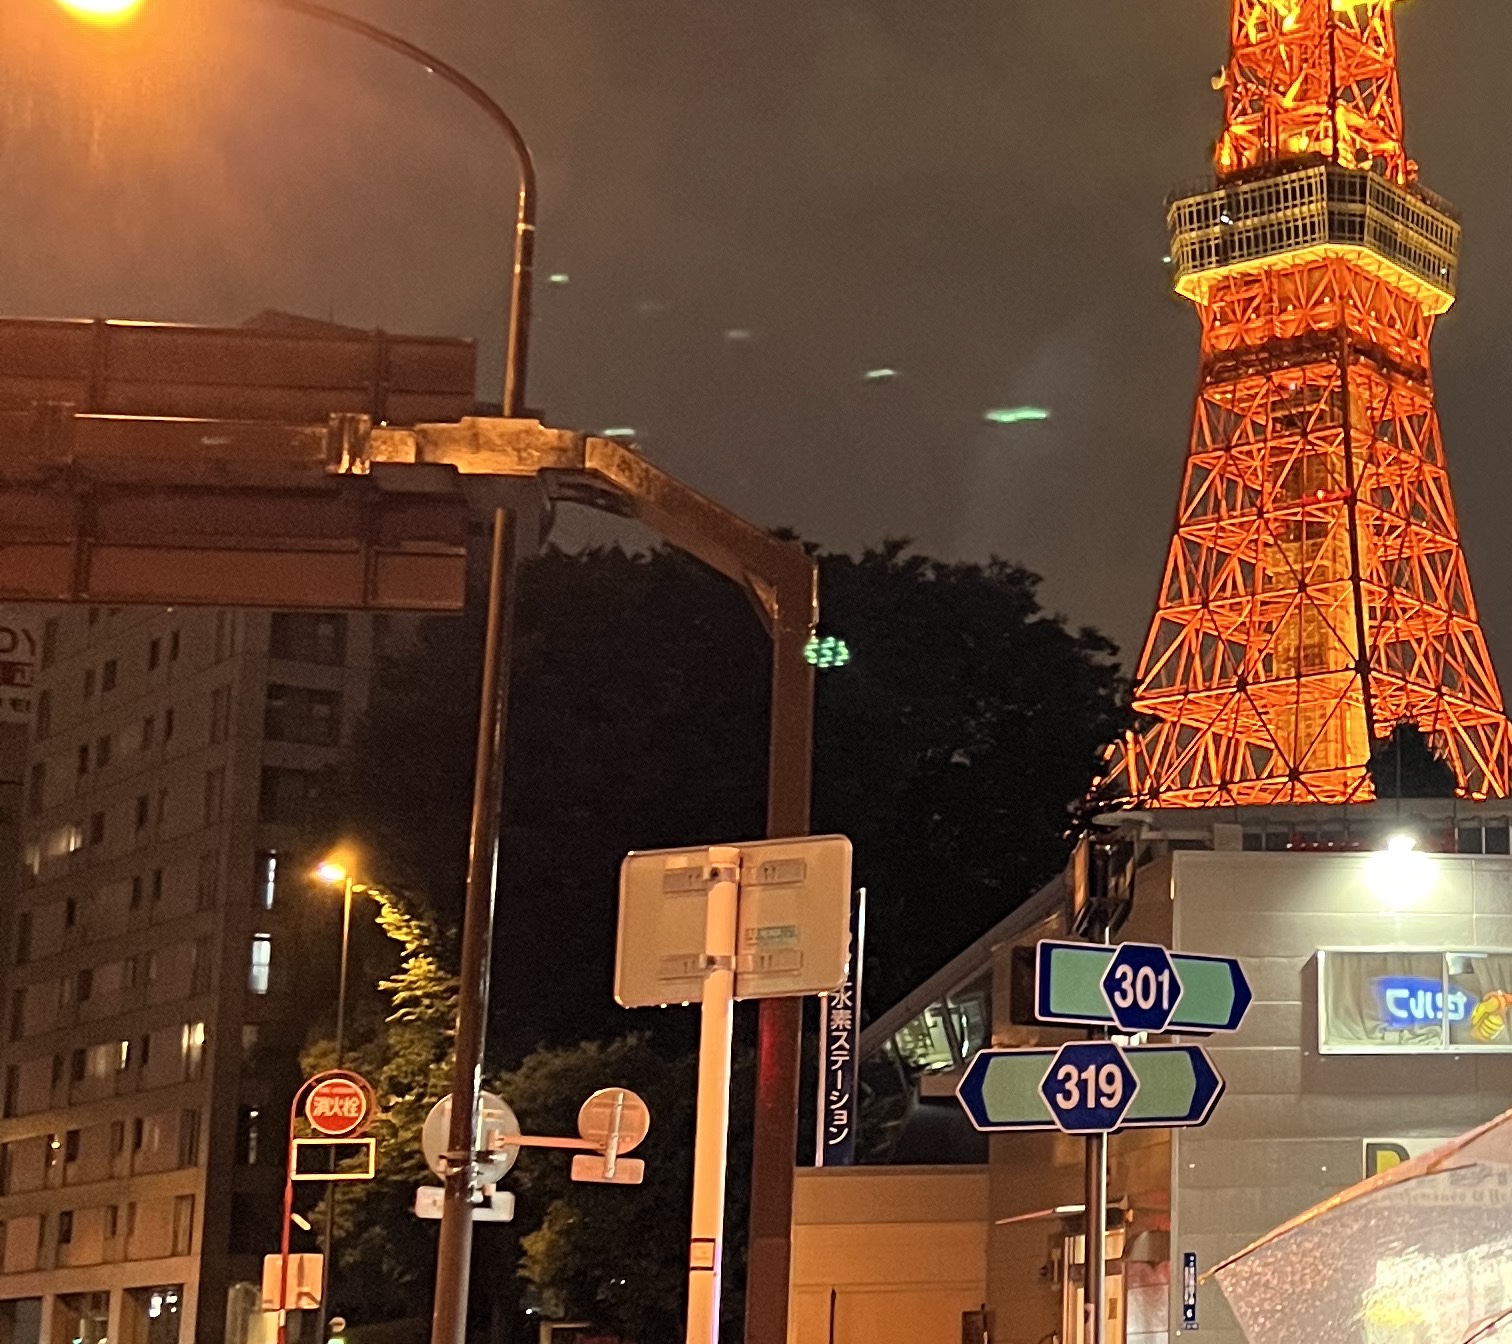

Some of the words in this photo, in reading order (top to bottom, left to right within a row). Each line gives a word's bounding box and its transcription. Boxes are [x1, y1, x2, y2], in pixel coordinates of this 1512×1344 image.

[1113, 964, 1170, 1010] 301
[313, 1096, 361, 1117] 消火栓
[1055, 1063, 1123, 1110] 319
